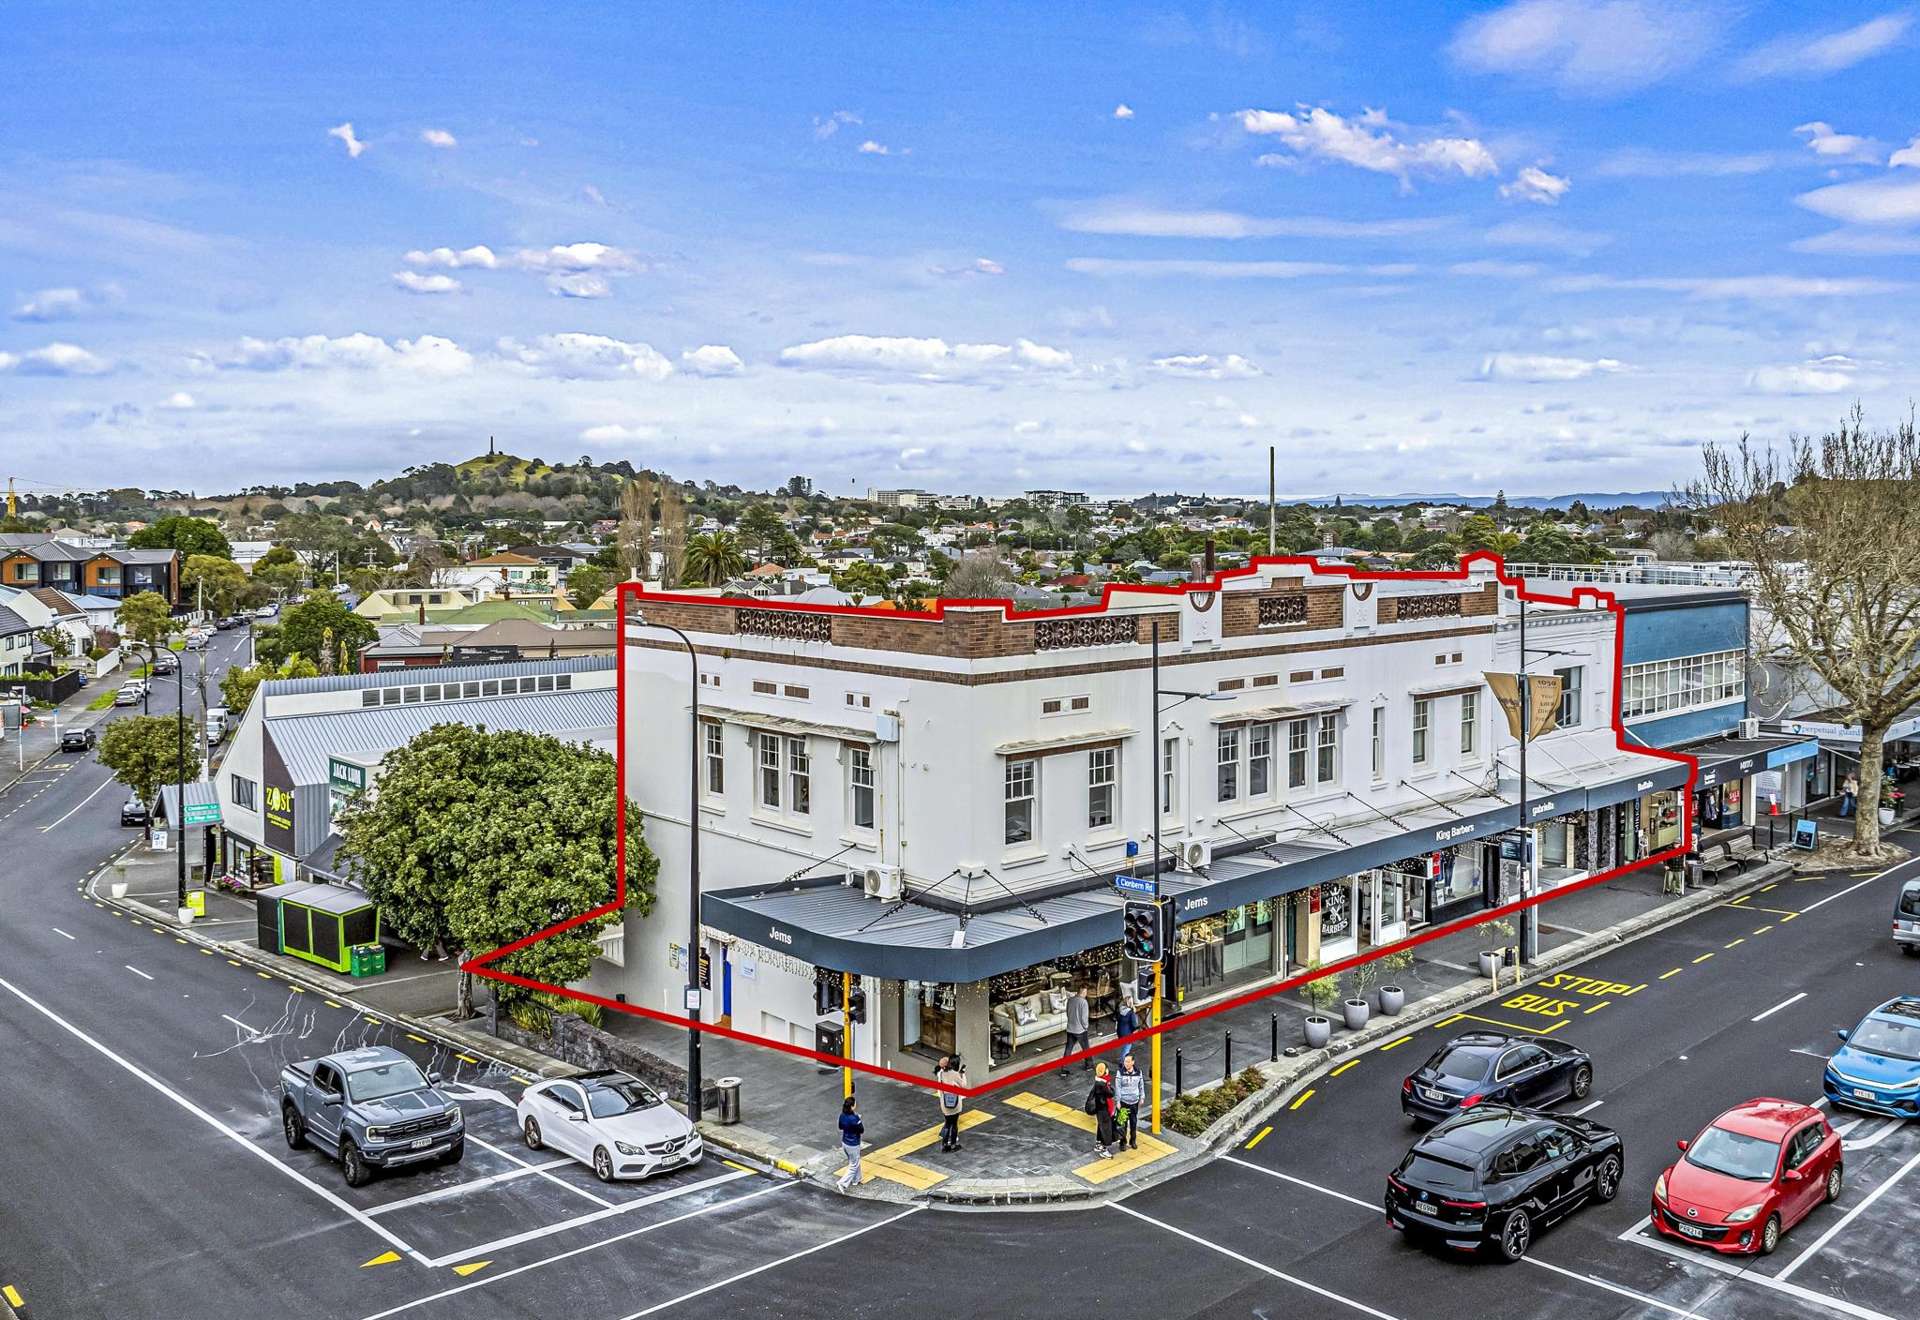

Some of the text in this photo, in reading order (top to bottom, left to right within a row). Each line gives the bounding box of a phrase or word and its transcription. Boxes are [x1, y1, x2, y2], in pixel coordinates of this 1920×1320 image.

[1436, 824, 1475, 841] King Barbers
[1145, 882, 1153, 892] Rd
[1184, 896, 1208, 911] Jems
[1326, 895, 1346, 908] KING
[769, 926, 793, 945] Jems
[1538, 973, 1631, 996] STOP
[1501, 993, 1580, 1016] BUS
